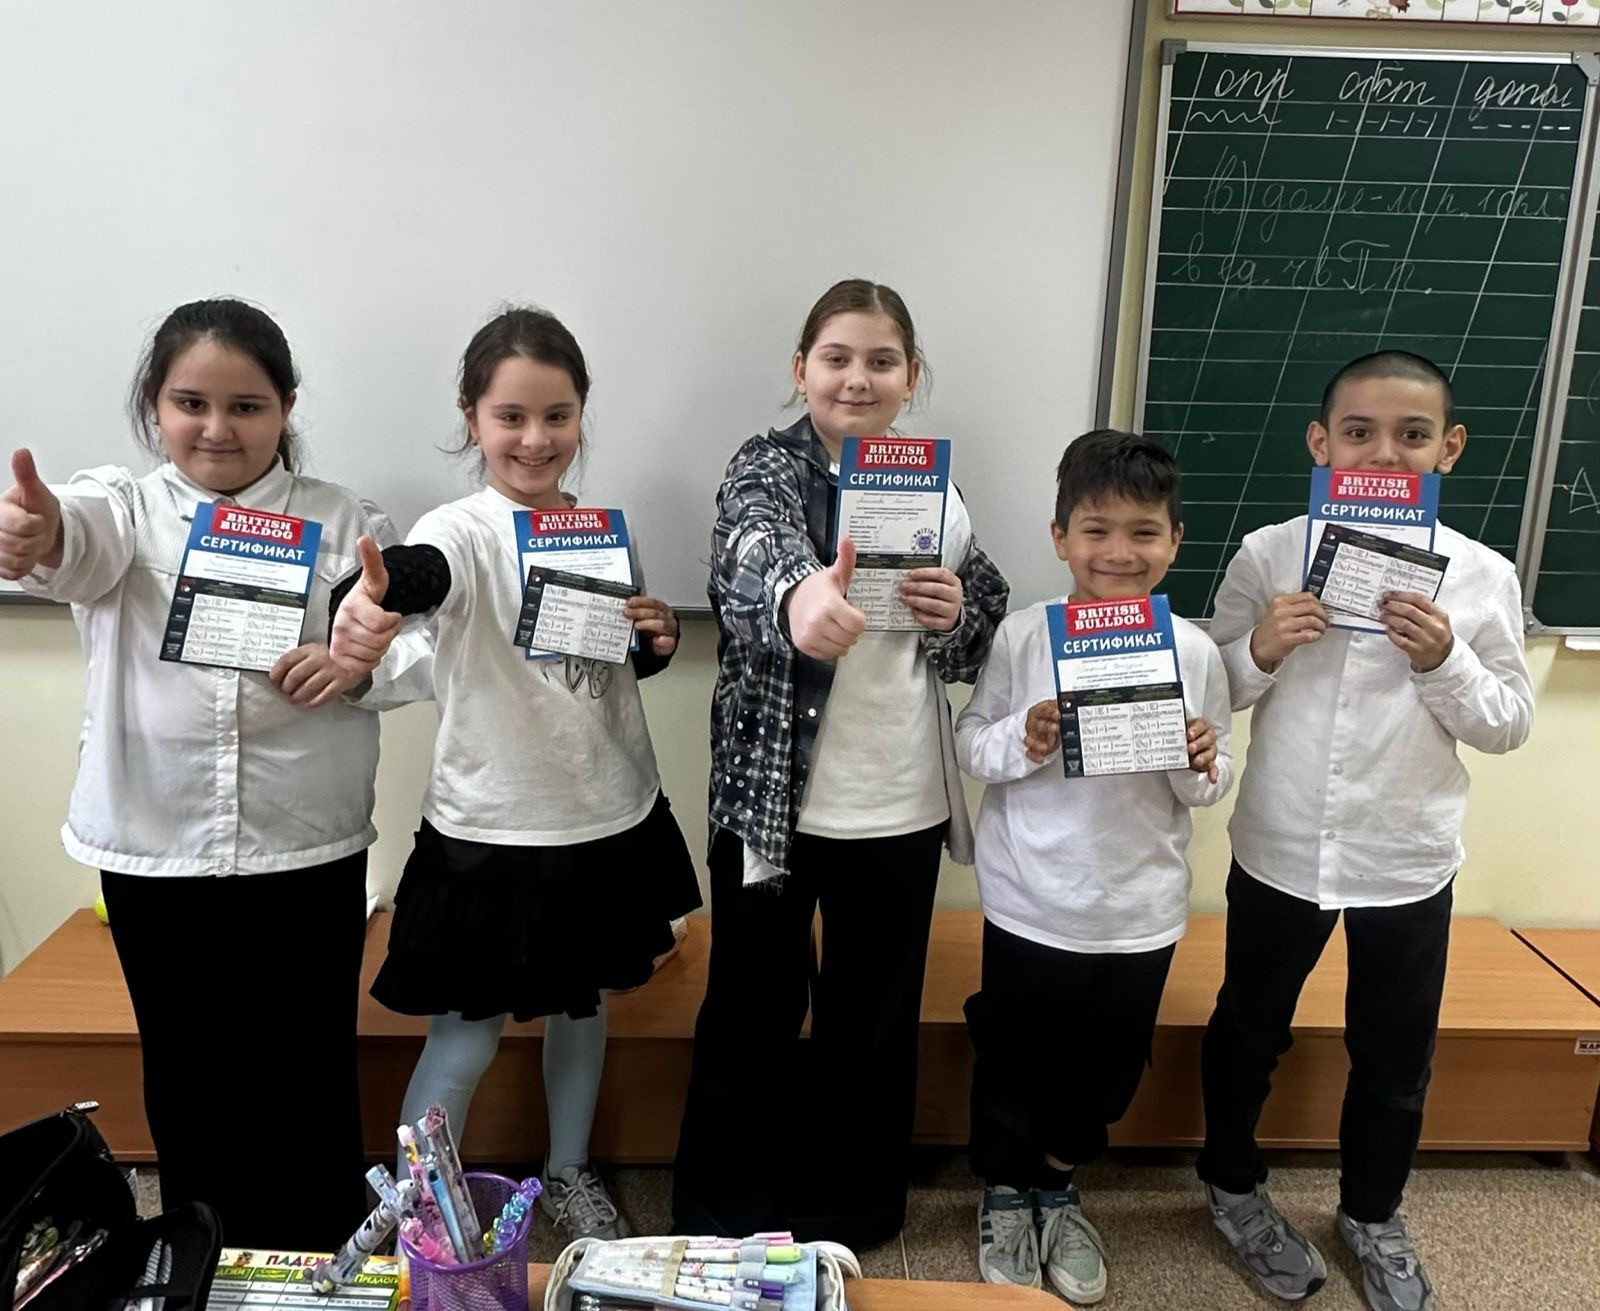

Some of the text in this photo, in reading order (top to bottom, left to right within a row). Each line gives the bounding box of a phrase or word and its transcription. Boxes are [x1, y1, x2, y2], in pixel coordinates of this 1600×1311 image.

[1213, 68, 1295, 115] опр
[869, 444, 925, 455] BRITISH
[864, 453, 928, 465] BULLDOG
[849, 473, 940, 487] СЕРТИФИКАТ
[1342, 475, 1408, 489] BRITISH
[1337, 485, 1411, 499] BULLDOG
[542, 513, 598, 523] BRITISH
[1321, 503, 1426, 522] СЕРТИФИКАТ
[226, 512, 292, 531] BRITISH
[539, 520, 603, 531] BULLDOG
[219, 520, 293, 540] BULLDOG
[200, 535, 305, 561] СЕРТИФИКАТ
[528, 534, 619, 548] СЕРТИФИКАТ
[1077, 603, 1140, 620] BRITISH
[1075, 613, 1146, 631] BULLDOG
[1063, 632, 1164, 654] СЕРТИФИКАТ
[265, 1254, 330, 1269] ПАДЕЖ
